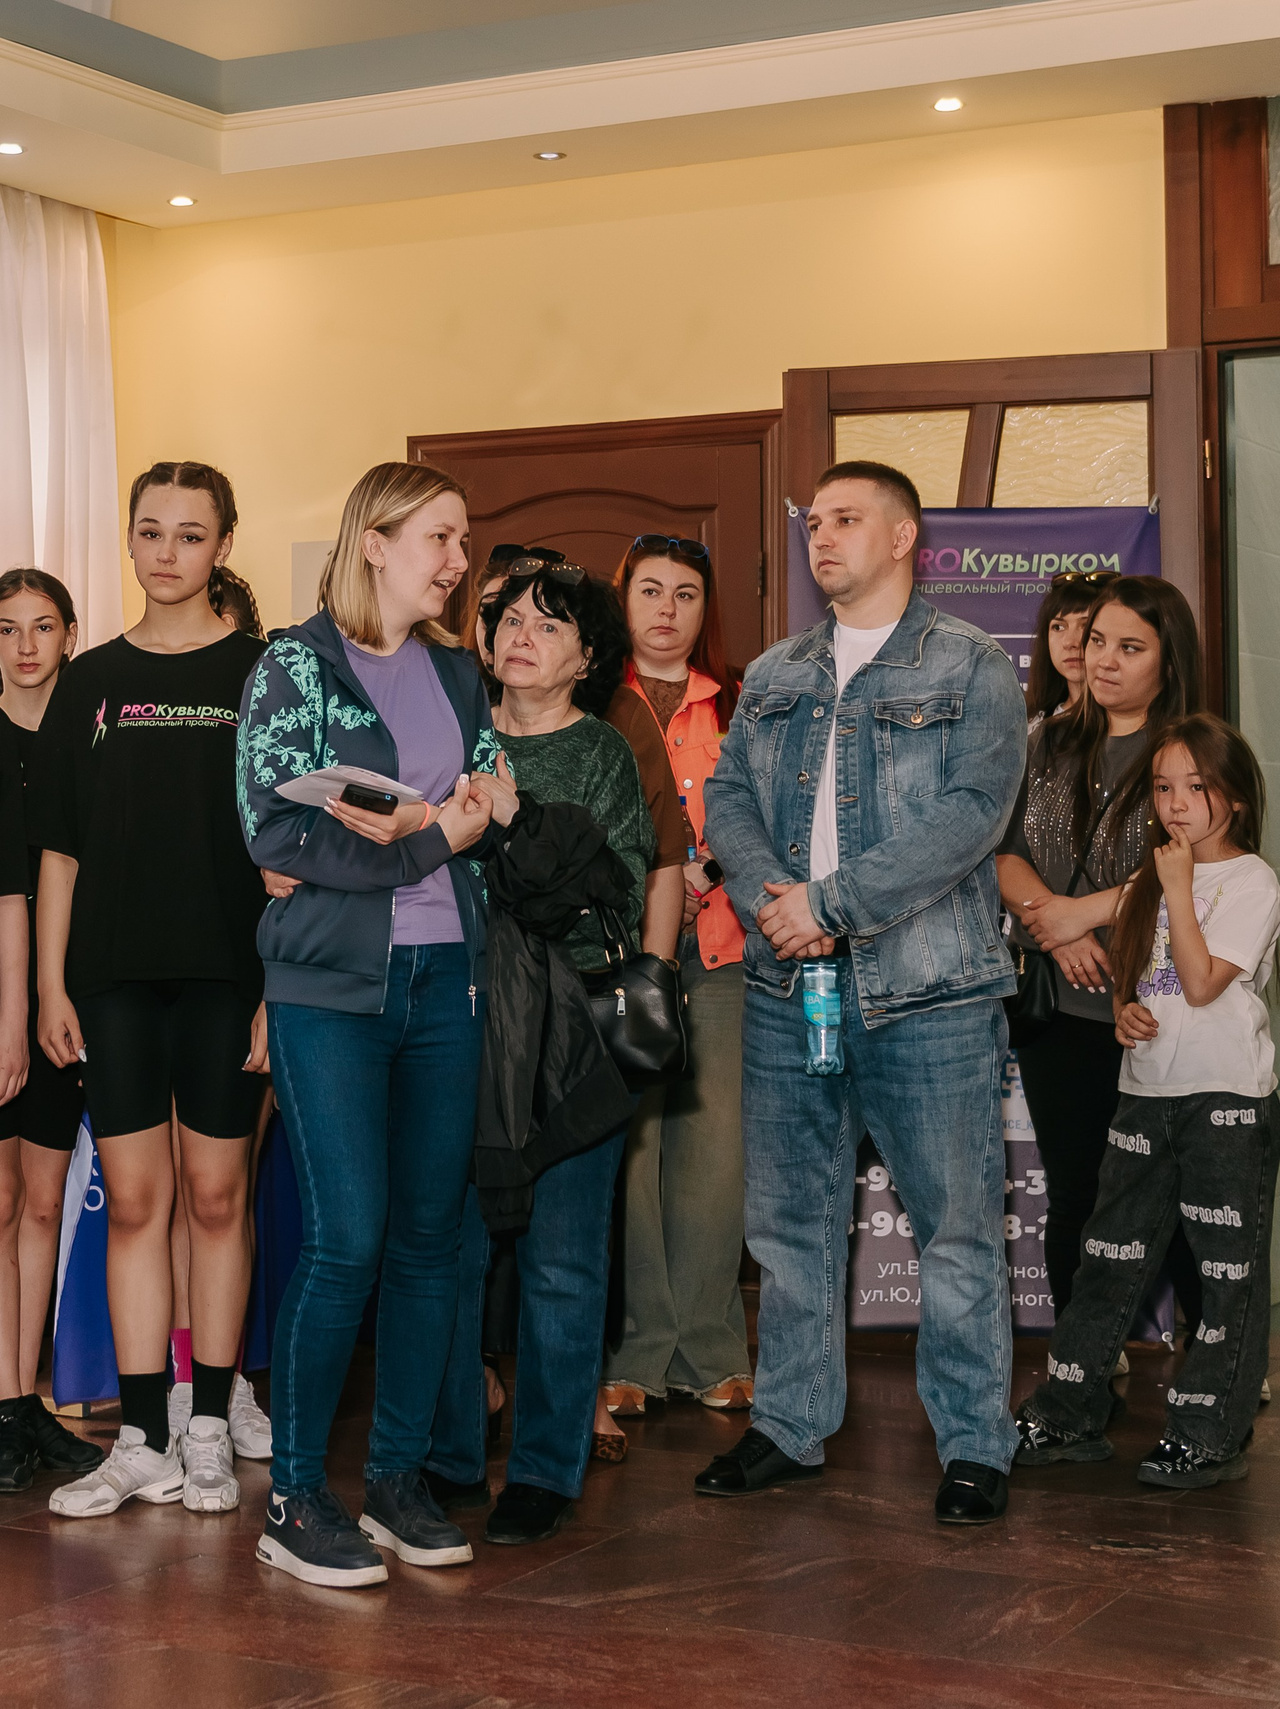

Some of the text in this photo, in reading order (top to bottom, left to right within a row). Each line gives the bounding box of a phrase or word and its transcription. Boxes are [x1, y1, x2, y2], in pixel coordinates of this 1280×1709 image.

[916, 548, 1120, 578] ROКувырком
[117, 719, 219, 728] танцевальный проект
[1180, 1202, 1242, 1227] crush
[1085, 1238, 1145, 1260] crush
